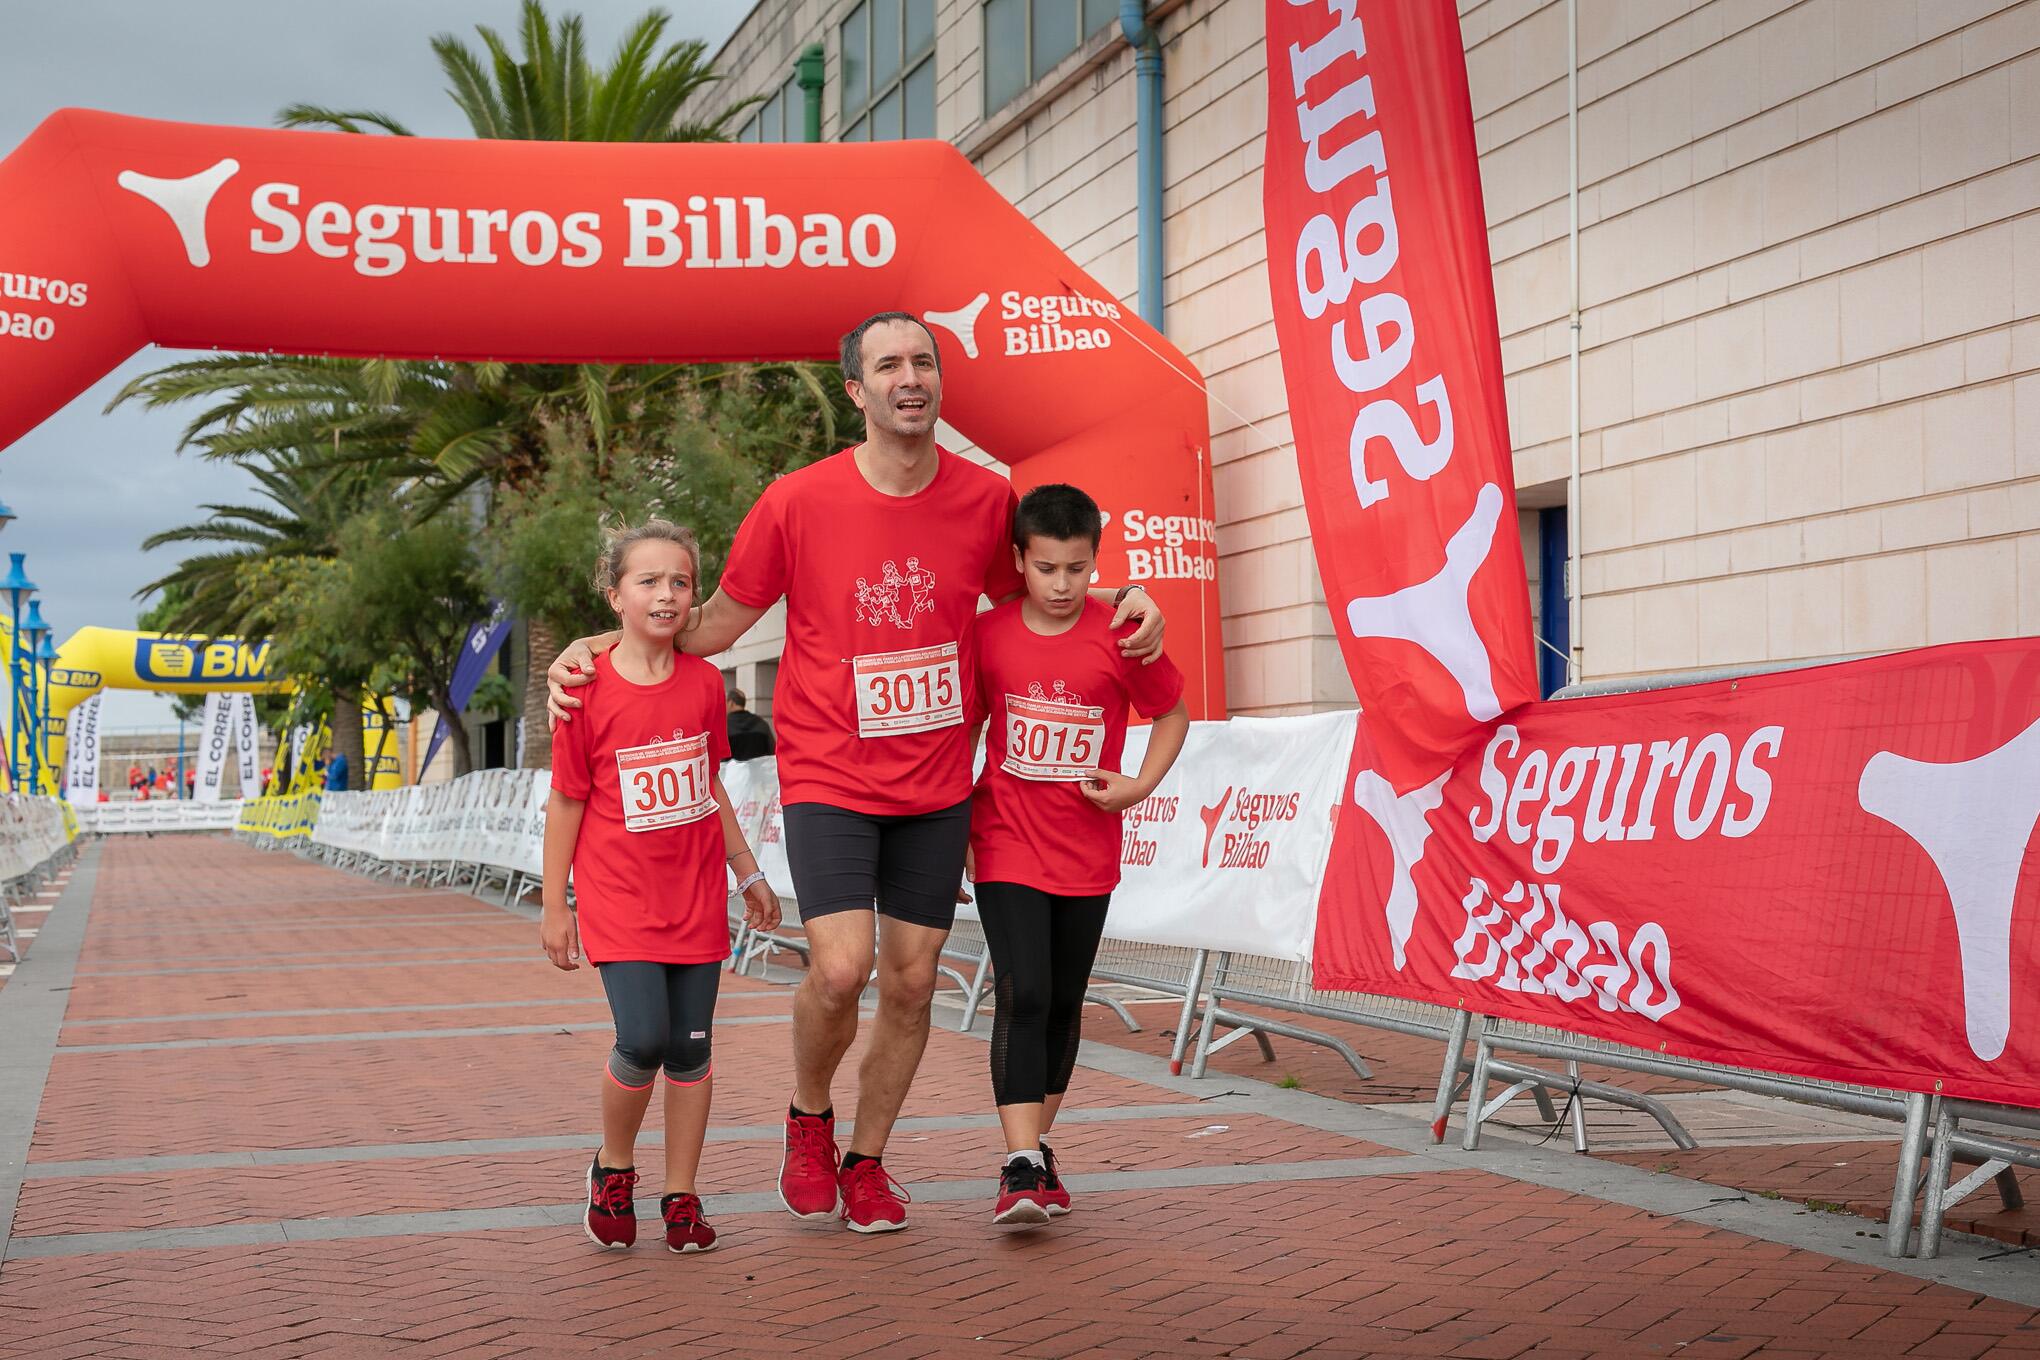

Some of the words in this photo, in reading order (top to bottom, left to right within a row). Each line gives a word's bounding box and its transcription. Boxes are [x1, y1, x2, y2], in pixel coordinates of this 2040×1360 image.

[250, 182, 603, 278] Seguros
[623, 195, 897, 269] Bilbao
[1001, 290, 1122, 324] Seguros
[1003, 323, 1112, 356] Bilbao
[1123, 509, 1216, 547] Seguro
[1126, 546, 1215, 581] Bilbao
[201, 643, 272, 678] BM
[869, 666, 953, 716] 3015
[1013, 719, 1094, 763] 3015
[206, 766, 219, 788] EL
[1229, 785, 1301, 830] Seguros
[1469, 723, 1785, 876] Seguros
[1120, 830, 1157, 867] ilbao
[1218, 832, 1270, 869] Bilbao
[1450, 875, 1681, 1022] Bilbao
